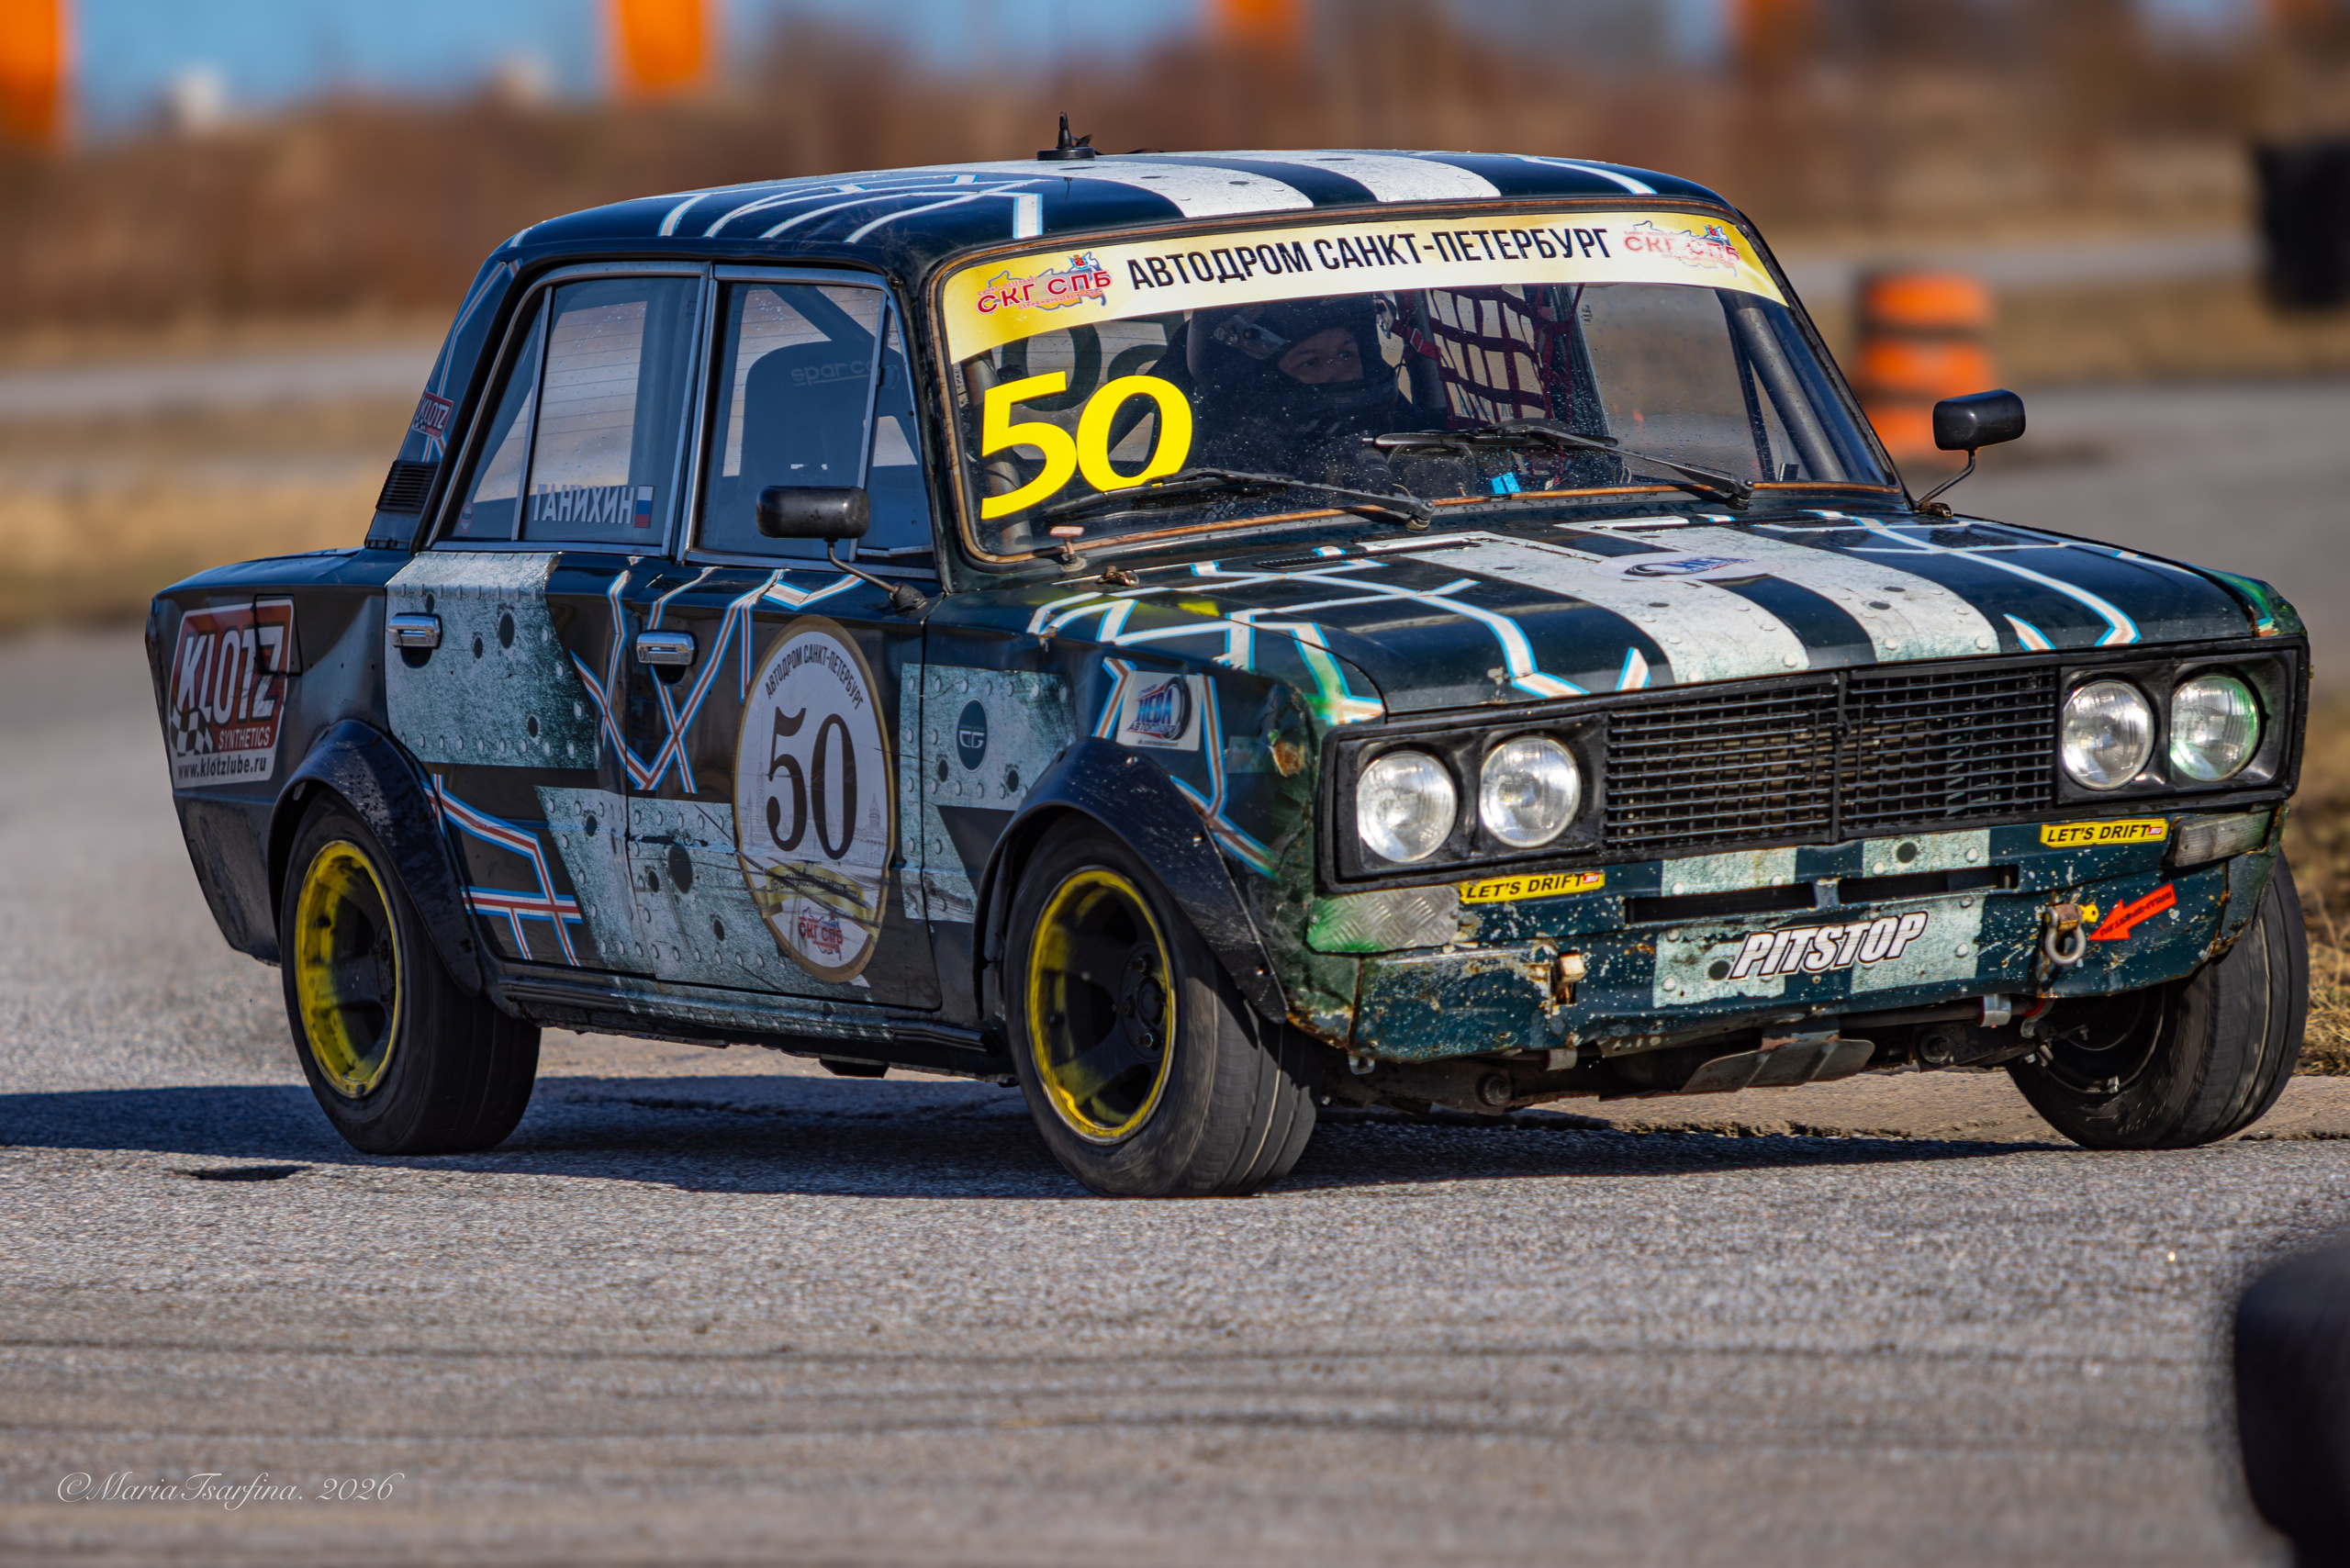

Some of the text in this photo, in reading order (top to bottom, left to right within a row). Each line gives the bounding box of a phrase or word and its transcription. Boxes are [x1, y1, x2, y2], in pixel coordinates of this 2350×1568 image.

[1126, 228, 1611, 290] АВТОДРОМ САНКТ-ПЕТЕРБУРГ
[1624, 236, 1675, 253] СКГ
[977, 270, 1113, 314] СКГ СПБ
[418, 398, 450, 430] KLOTZ
[979, 370, 1193, 521] 50
[533, 483, 635, 524] ГАНИХИН
[176, 623, 285, 725] KLOTZ
[765, 643, 864, 711] АВТОДРОМ САНКТ-ПЕТЕРБУРГ
[218, 726, 271, 751] SYNTHETICS
[177, 755, 267, 779] www.klotzlube.ru
[766, 706, 857, 860] 50
[2046, 826, 2095, 843] LET'S
[1466, 881, 1521, 899] LET'S
[1728, 910, 1929, 980] PITSTOP
